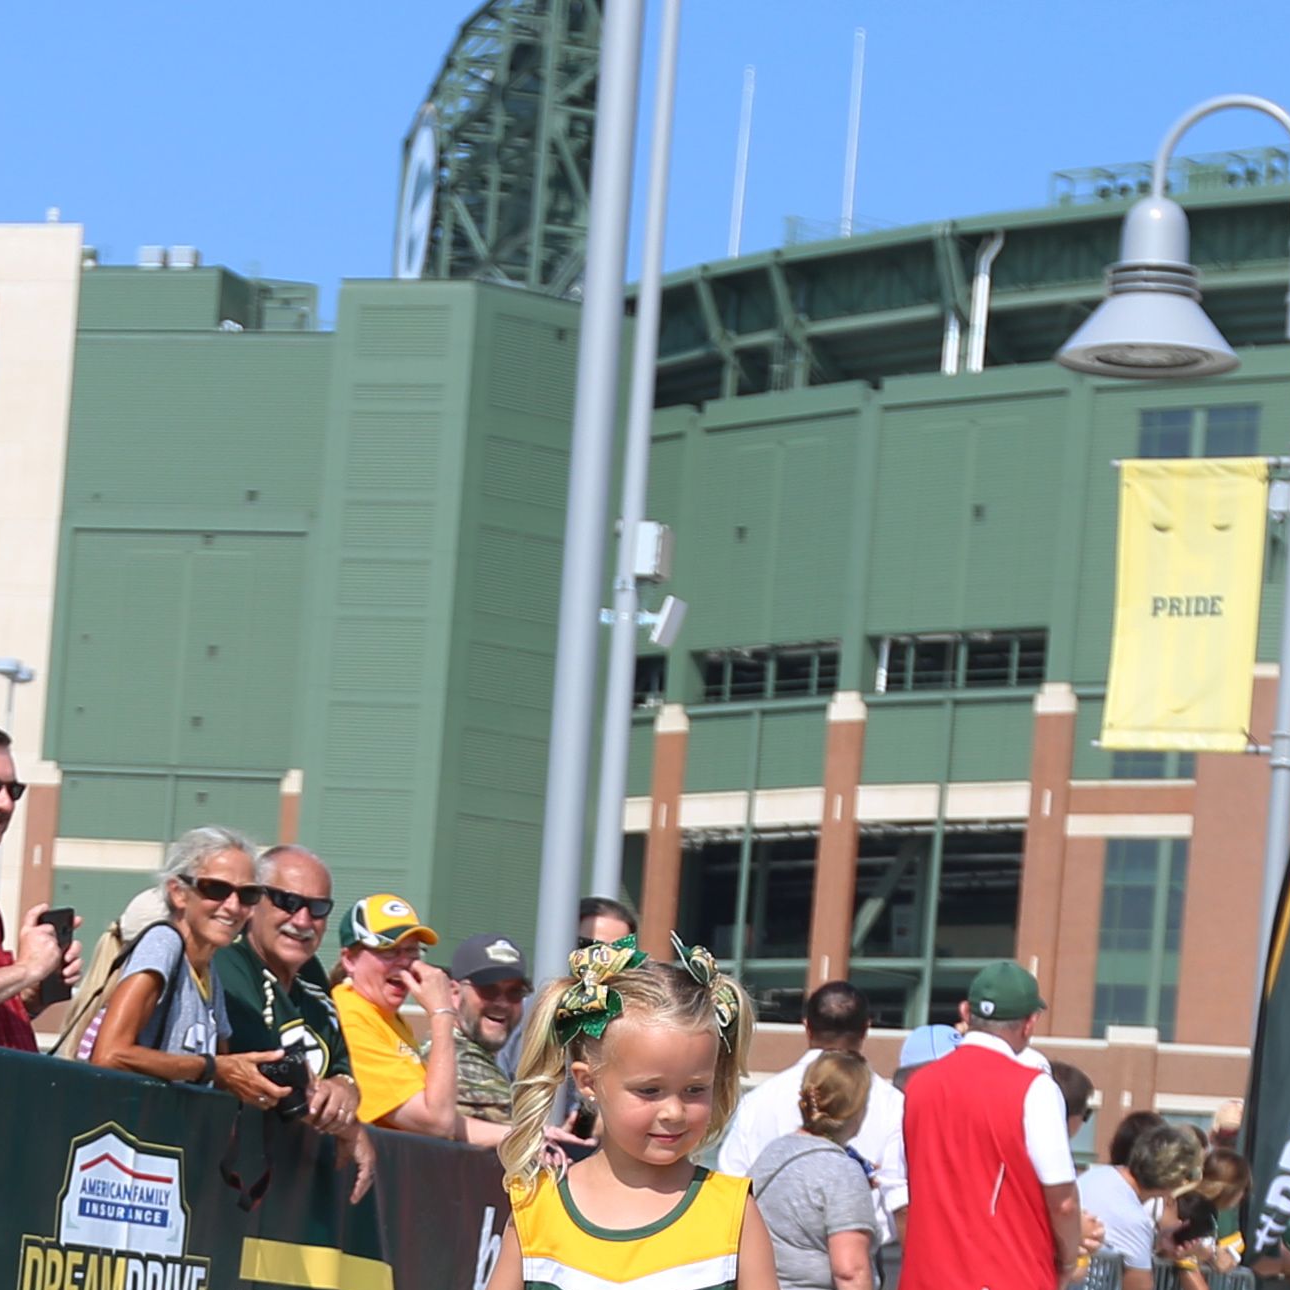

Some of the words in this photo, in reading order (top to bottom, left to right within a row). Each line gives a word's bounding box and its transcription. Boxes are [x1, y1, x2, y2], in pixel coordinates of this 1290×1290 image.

[1151, 595, 1224, 617] PRIDE
[80, 1178, 133, 1200] AMERICAN
[131, 1185, 171, 1206] FAMILY
